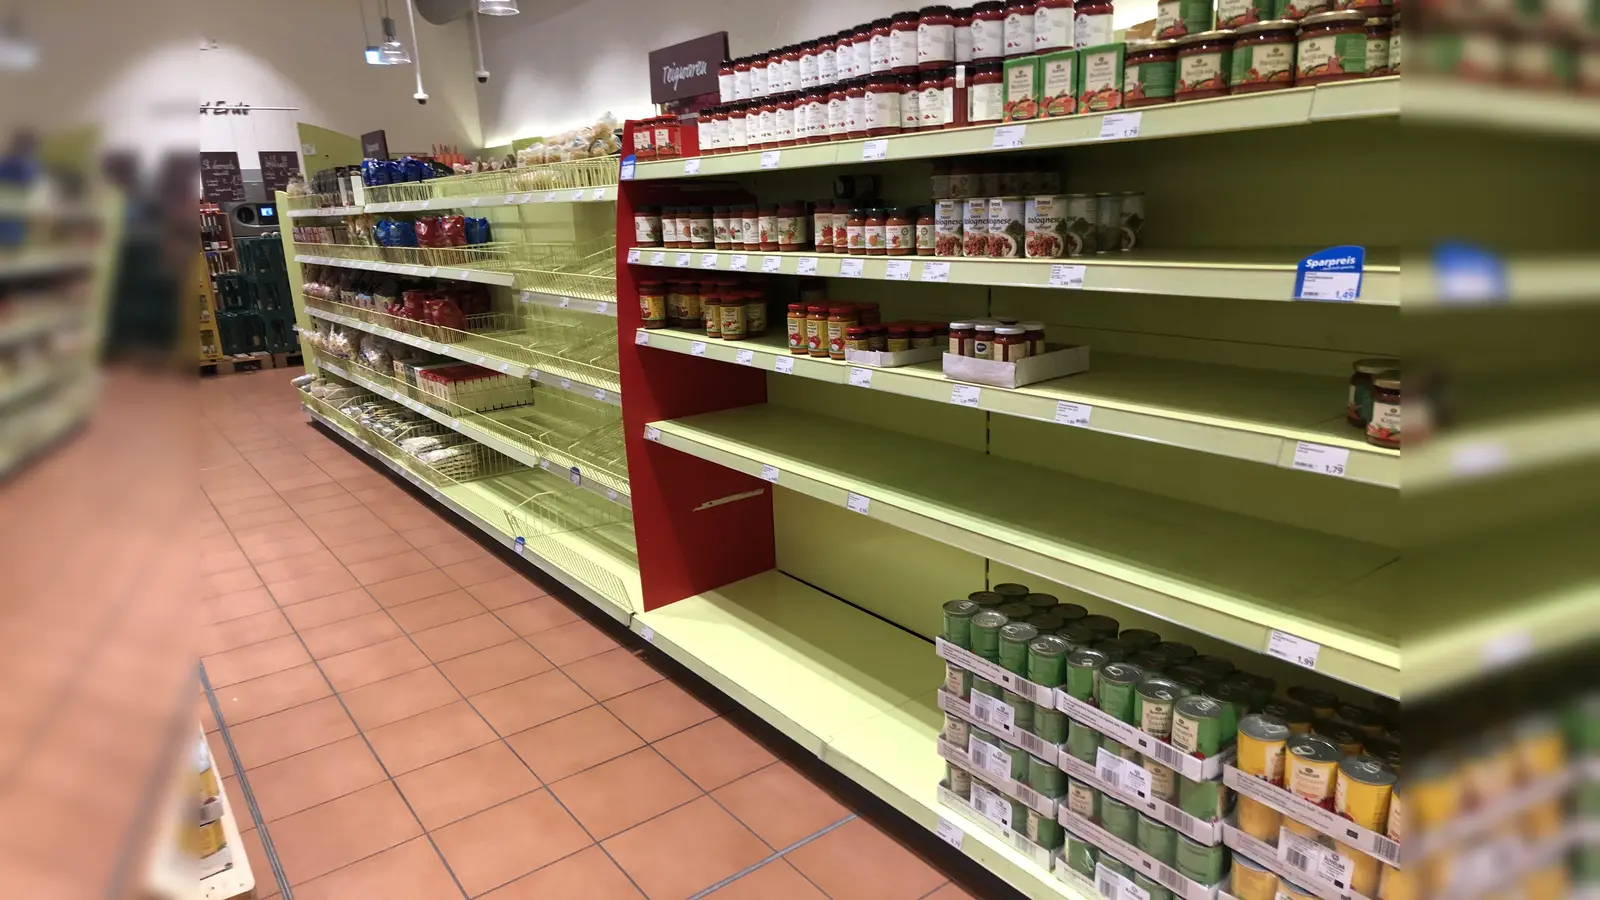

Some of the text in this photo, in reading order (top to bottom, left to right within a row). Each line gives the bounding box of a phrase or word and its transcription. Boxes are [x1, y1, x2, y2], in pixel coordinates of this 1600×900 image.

[662, 61, 708, 91] Teigwaren
[1305, 255, 1357, 269] Sparpreis
[1325, 464, 1344, 475] 1,79
